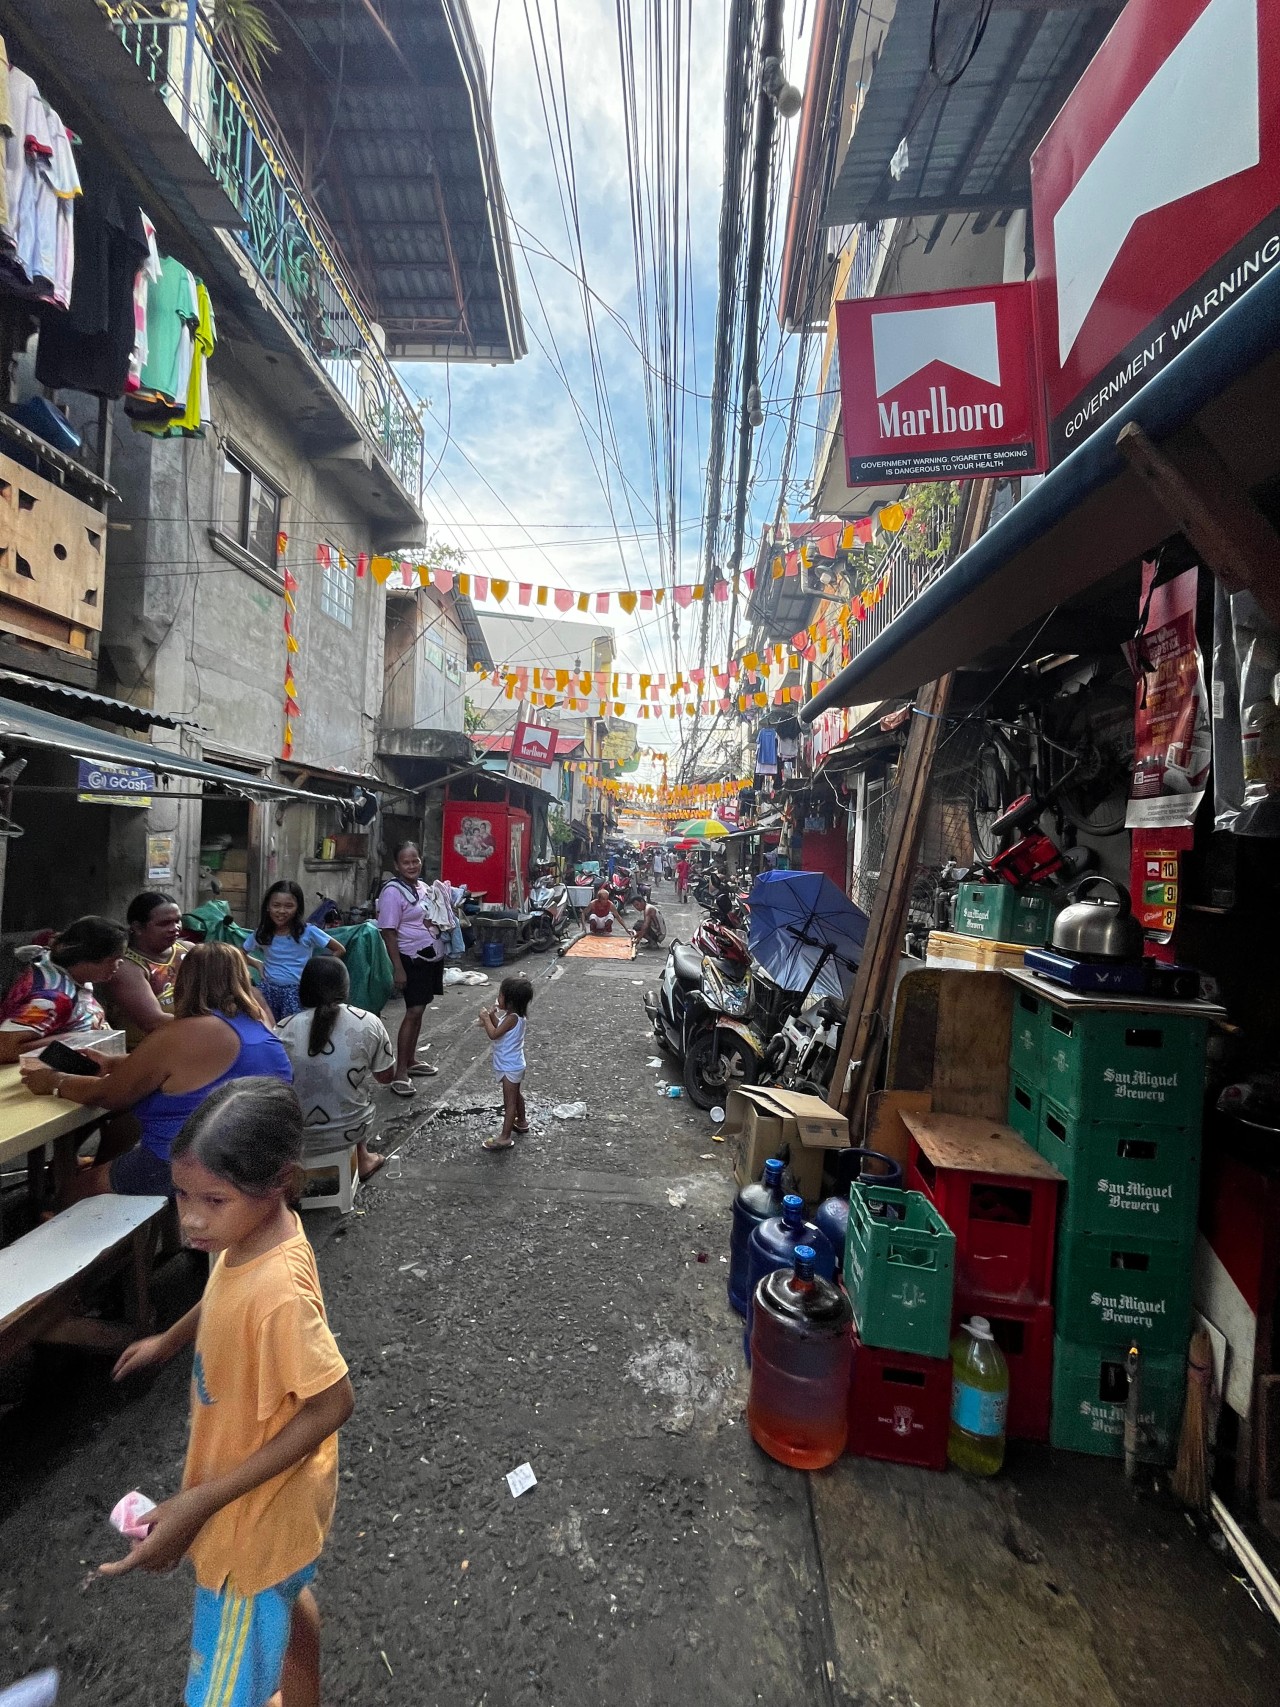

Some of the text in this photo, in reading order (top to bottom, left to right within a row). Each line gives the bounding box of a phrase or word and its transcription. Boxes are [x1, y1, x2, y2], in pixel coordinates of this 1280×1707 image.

[1065, 332, 1167, 438] GOVERNMENT
[877, 386, 1004, 438] Marlboro
[861, 459, 911, 469] GOVERNMENT
[951, 453, 991, 462] CIGARETTE
[993, 450, 1027, 459] SMOKING
[895, 465, 940, 475] DANGEROUS
[953, 462, 974, 470] YOUR
[976, 460, 1003, 468] HEALTH
[110, 776, 147, 791] GCash
[1104, 1068, 1178, 1088] San Miguel
[1115, 1084, 1165, 1102] Brewery
[1097, 1179, 1172, 1199] San Miguel
[1108, 1195, 1160, 1213] Brewery
[1090, 1292, 1166, 1313] San Miguel
[1101, 1308, 1153, 1328] Brewery
[1080, 1400, 1107, 1416] San
